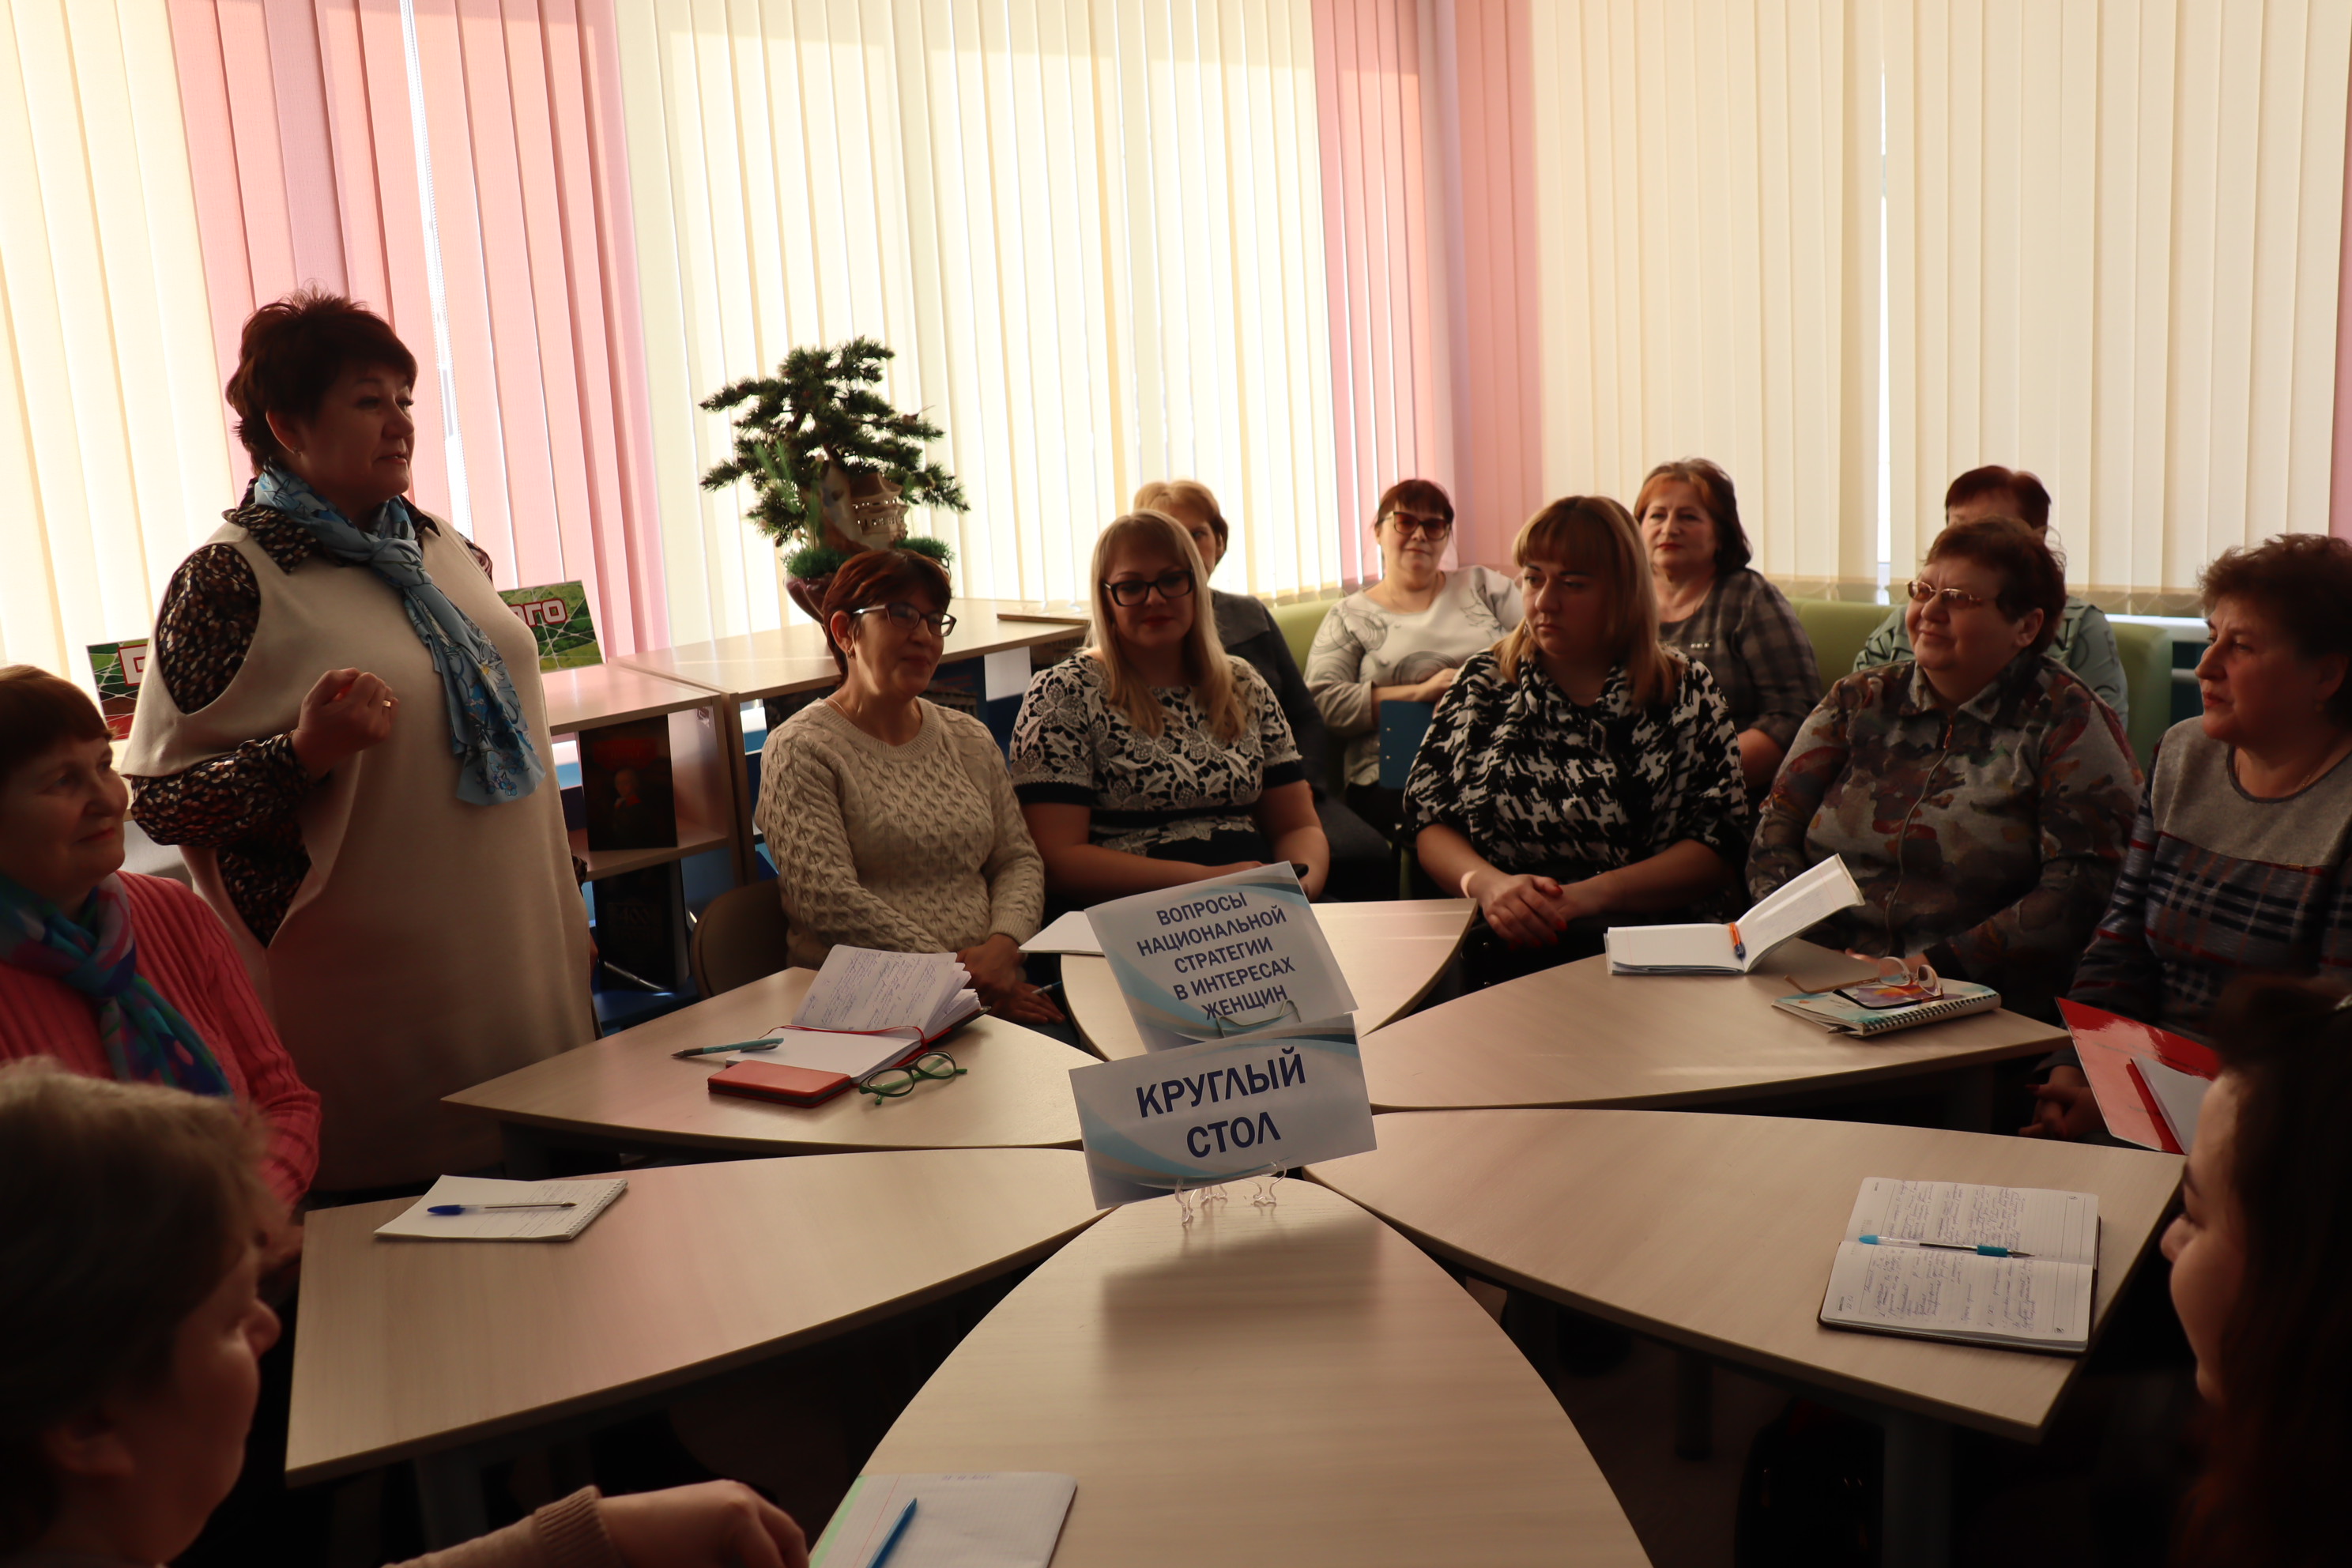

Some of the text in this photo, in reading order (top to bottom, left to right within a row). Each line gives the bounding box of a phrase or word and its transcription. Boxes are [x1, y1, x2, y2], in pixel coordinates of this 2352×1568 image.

[1136, 904, 1287, 957] НАЦИОНАЛЬНОЙ
[1155, 891, 1248, 926] ВОПРОСЫ
[1174, 937, 1273, 974] СТРАТЕГИИ
[1173, 956, 1296, 1001] В ИНТЕРЕСАХ
[1201, 984, 1289, 1021] ЖЕНЩИН
[1136, 1046, 1306, 1118] КРУГЛЫЙ
[1186, 1111, 1282, 1159] СТОЛ
